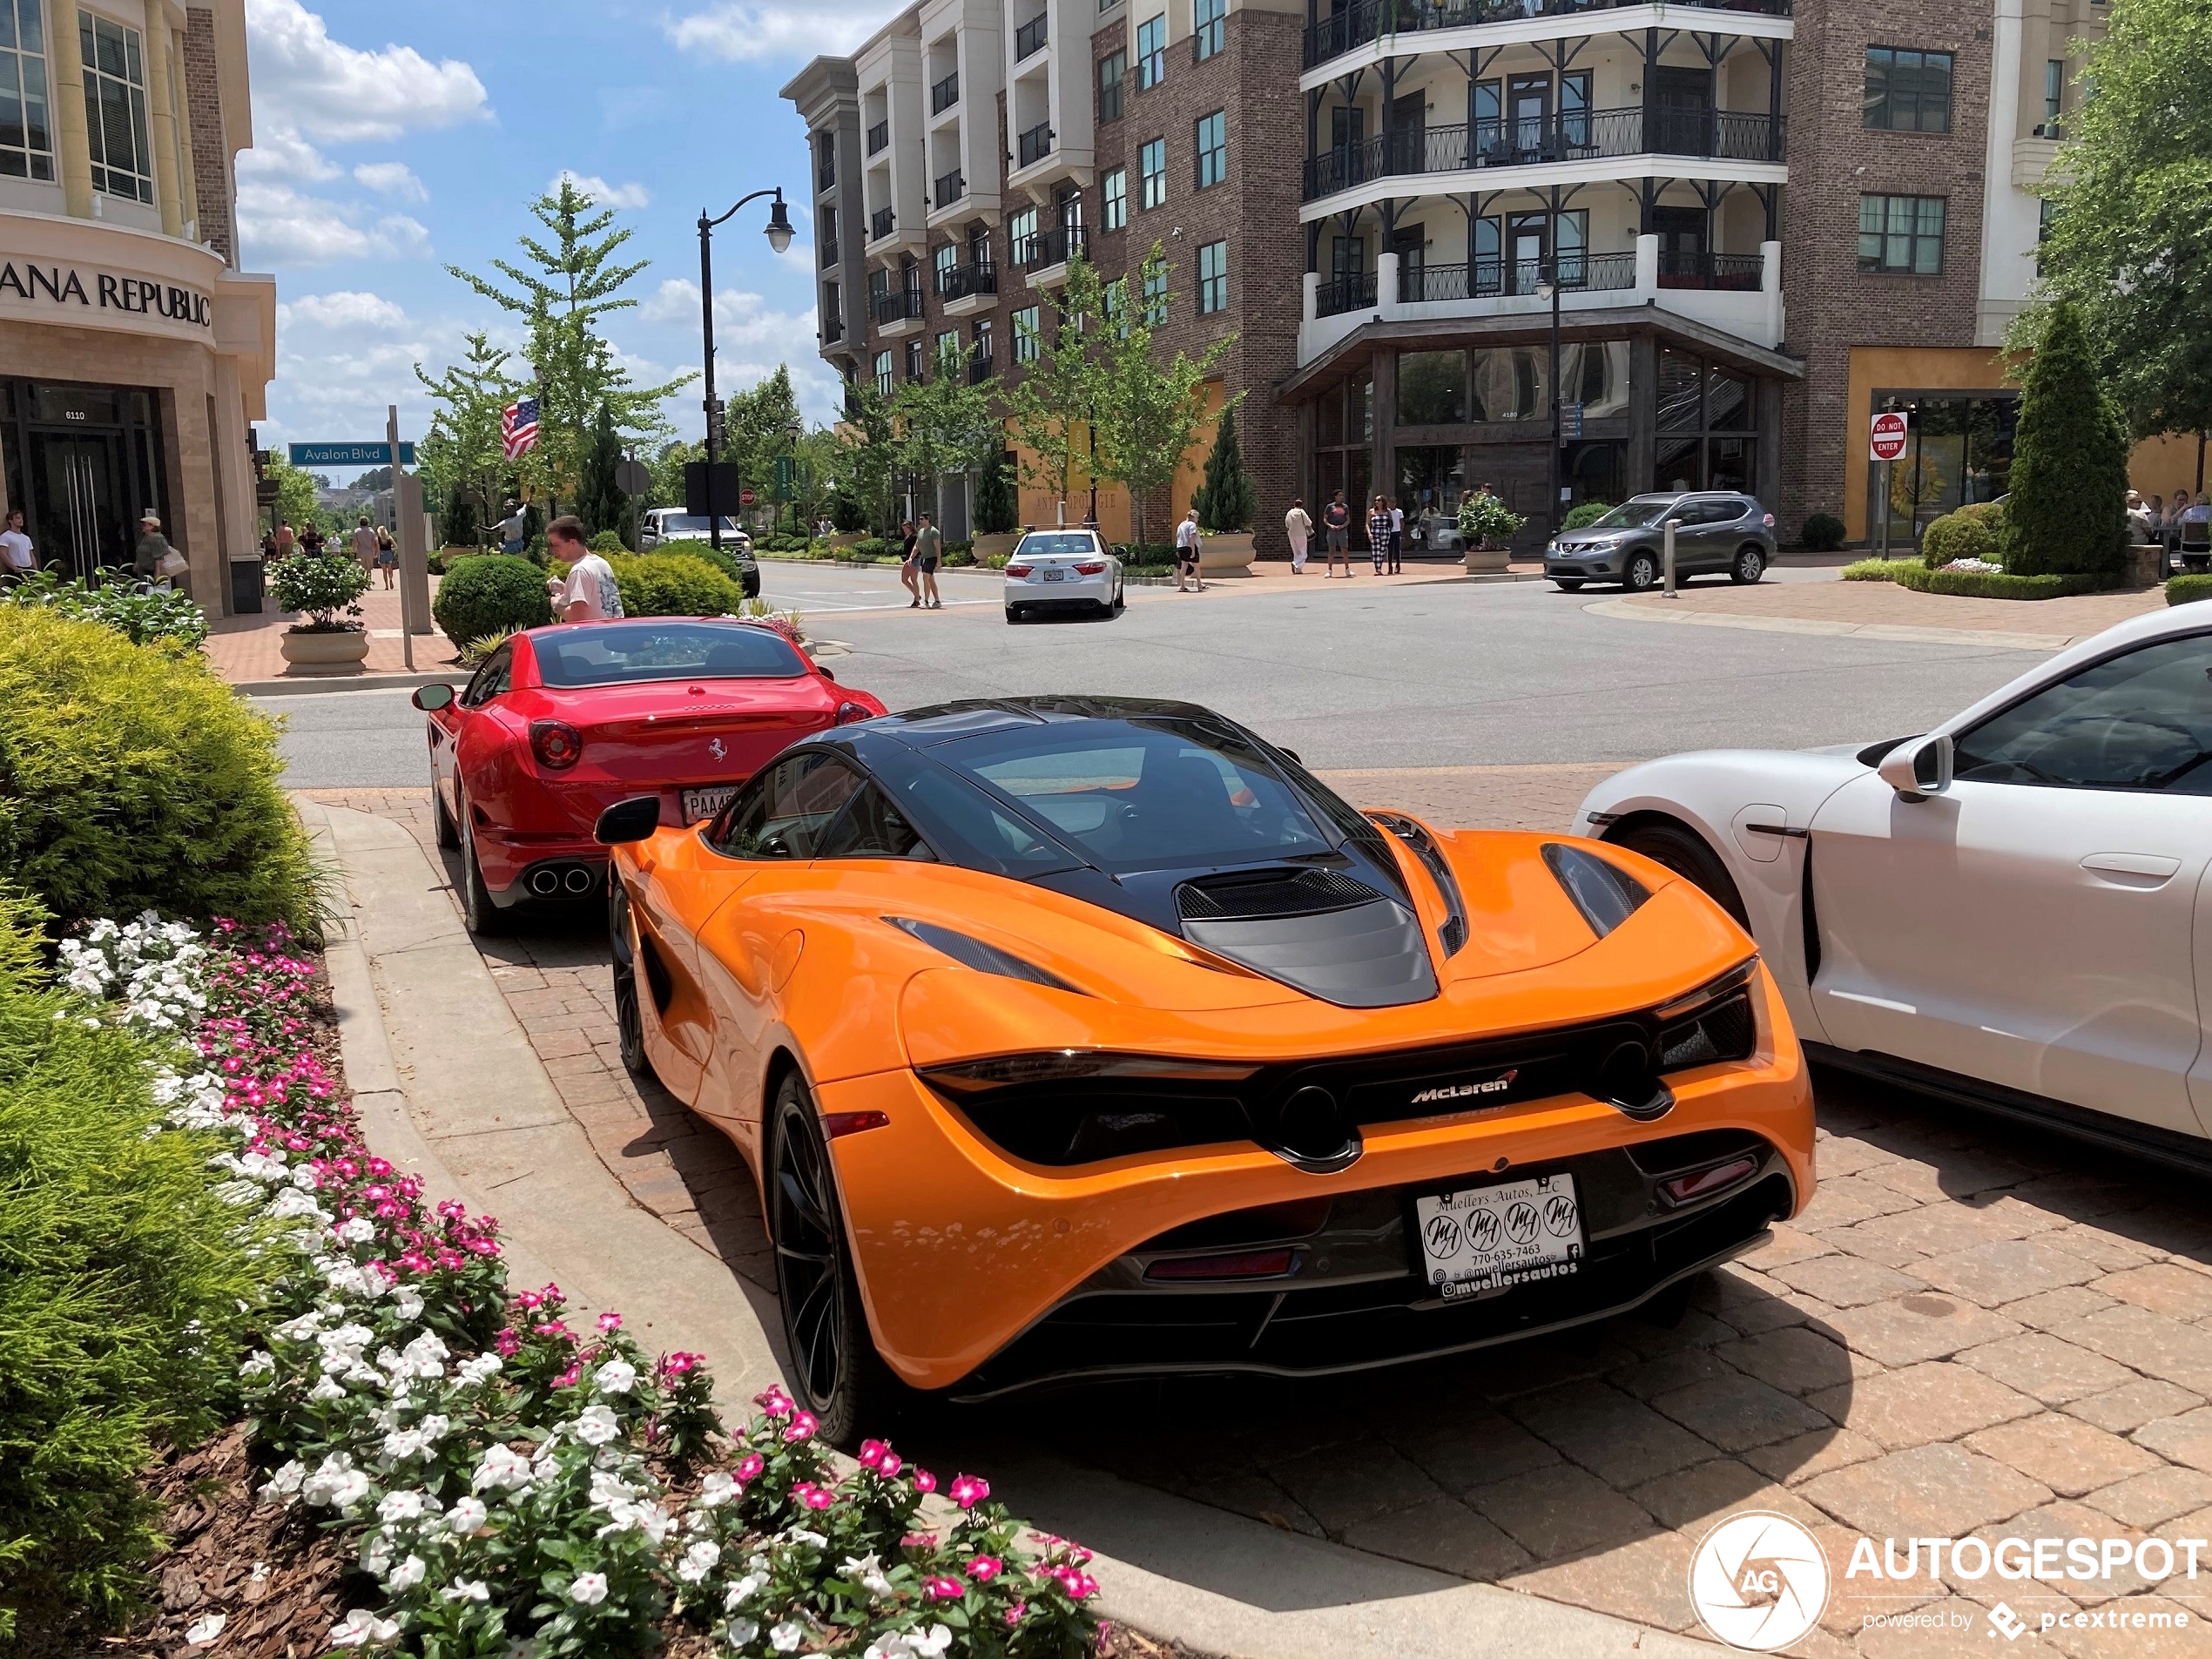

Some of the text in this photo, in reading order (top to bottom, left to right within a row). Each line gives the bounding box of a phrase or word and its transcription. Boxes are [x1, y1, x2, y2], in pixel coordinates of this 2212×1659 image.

[98, 273, 211, 327] REPUBLIC
[65, 410, 85, 421] 6110
[305, 448, 381, 461] Avalon Blvd
[1878, 442, 1898, 451] ENTER
[1036, 494, 1116, 510] ANTHOPOLGIE
[1411, 1079, 1508, 1103] McLaren
[1494, 1188, 1533, 1204] Autos,
[1472, 1244, 1541, 1266] 770-635-7463
[1464, 1254, 1550, 1279] @muellersautos
[1456, 1262, 1578, 1295] muellersautos
